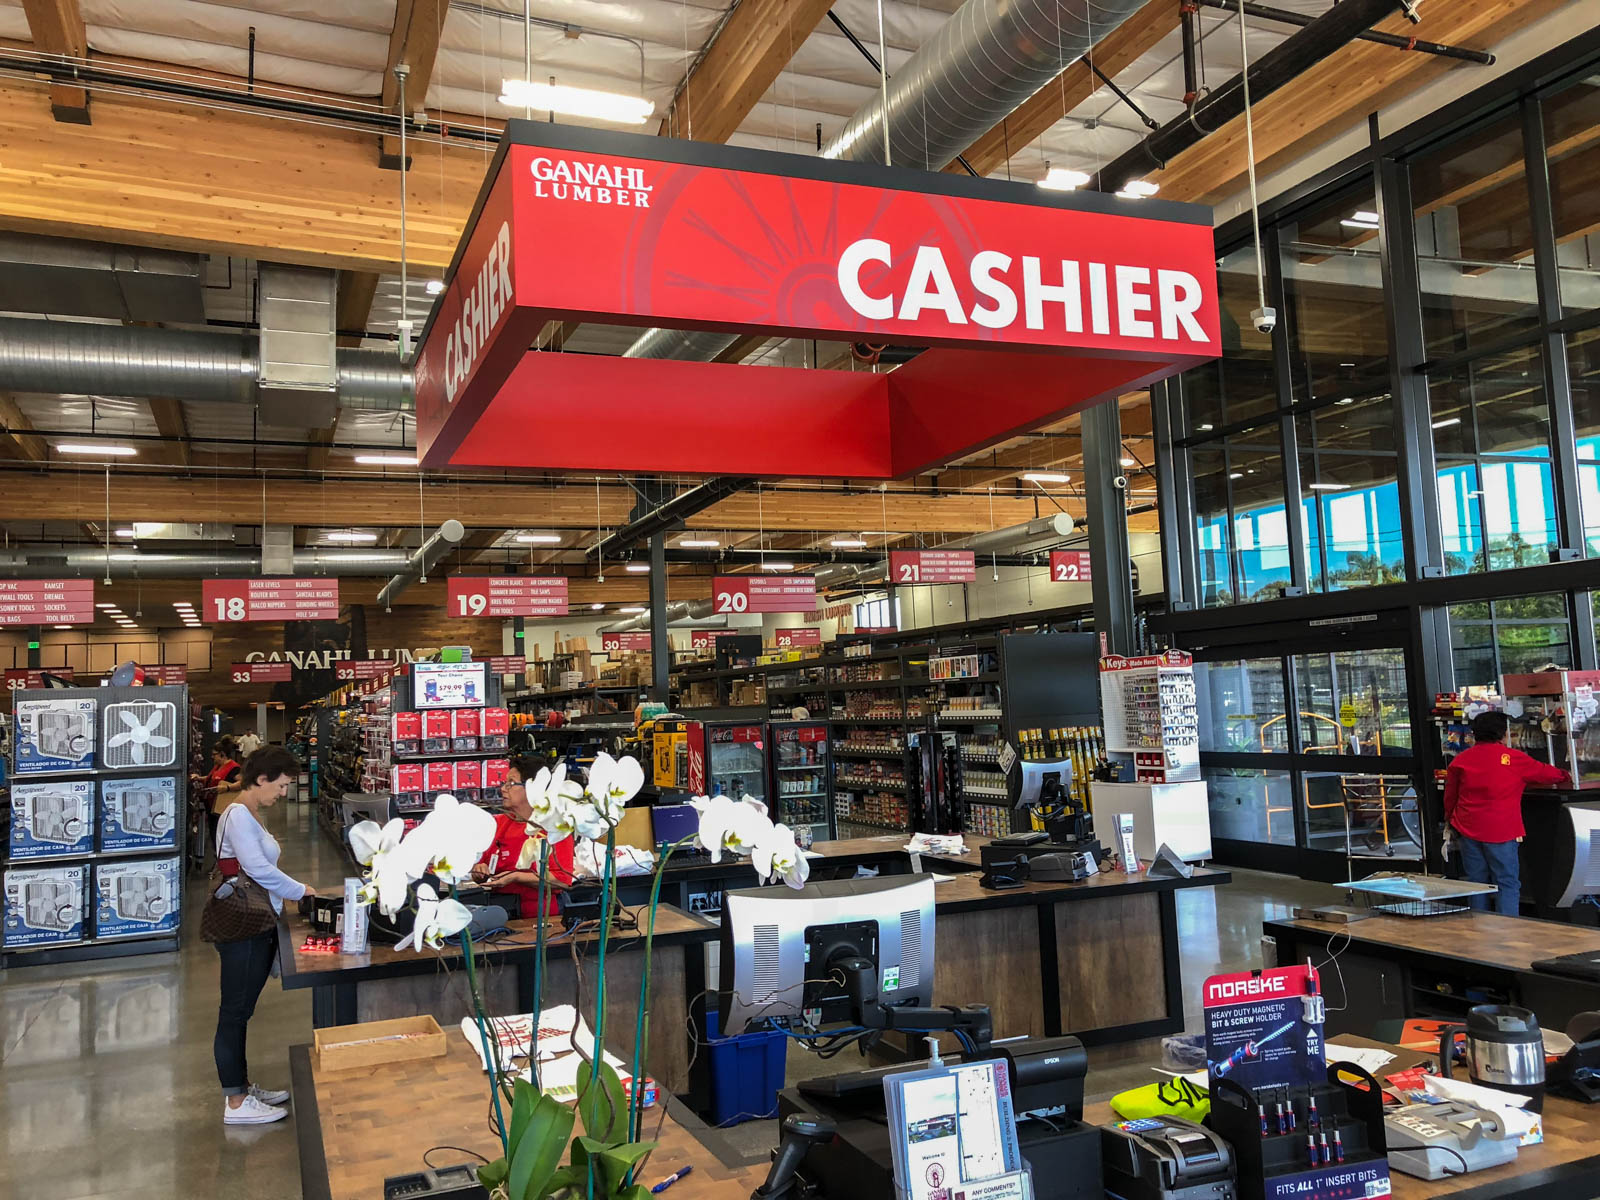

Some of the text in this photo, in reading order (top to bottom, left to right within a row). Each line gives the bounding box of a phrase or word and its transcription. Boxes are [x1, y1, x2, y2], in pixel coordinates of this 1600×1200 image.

[530, 157, 653, 192] GANAHL
[534, 180, 651, 208] LUMBER
[836, 238, 1211, 342] CASHIER
[445, 221, 513, 403] CASHIER
[900, 564, 920, 581] 21
[1056, 564, 1079, 580] 22
[214, 597, 246, 620] 18
[457, 594, 487, 616] 19
[717, 592, 748, 612] 20
[825, 603, 852, 619] LUMBER
[604, 640, 619, 650] 30
[694, 638, 707, 649] 29
[779, 636, 792, 646] 28
[1106, 658, 1128, 669] Keys
[233, 671, 251, 683] 33
[338, 669, 354, 679] 32
[7, 679, 26, 690] 35
[1211, 1003, 1286, 1020] HEAVY DUTY MAGNETIC
[1211, 1012, 1282, 1029] BIT & SCREW HOLDER
[1306, 1038, 1318, 1046] TRY
[1307, 1046, 1320, 1055] ME
[1044, 1057, 1060, 1065] EPSON
[1003, 1101, 1012, 1136] BUILDING
[972, 1188, 983, 1196] ANY
[984, 1182, 1016, 1194] COMMENTS?
[1276, 1181, 1295, 1195] FITS
[1297, 1178, 1314, 1192] ALL
[1325, 1174, 1357, 1187] INSERT
[1358, 1169, 1377, 1181] BITS
